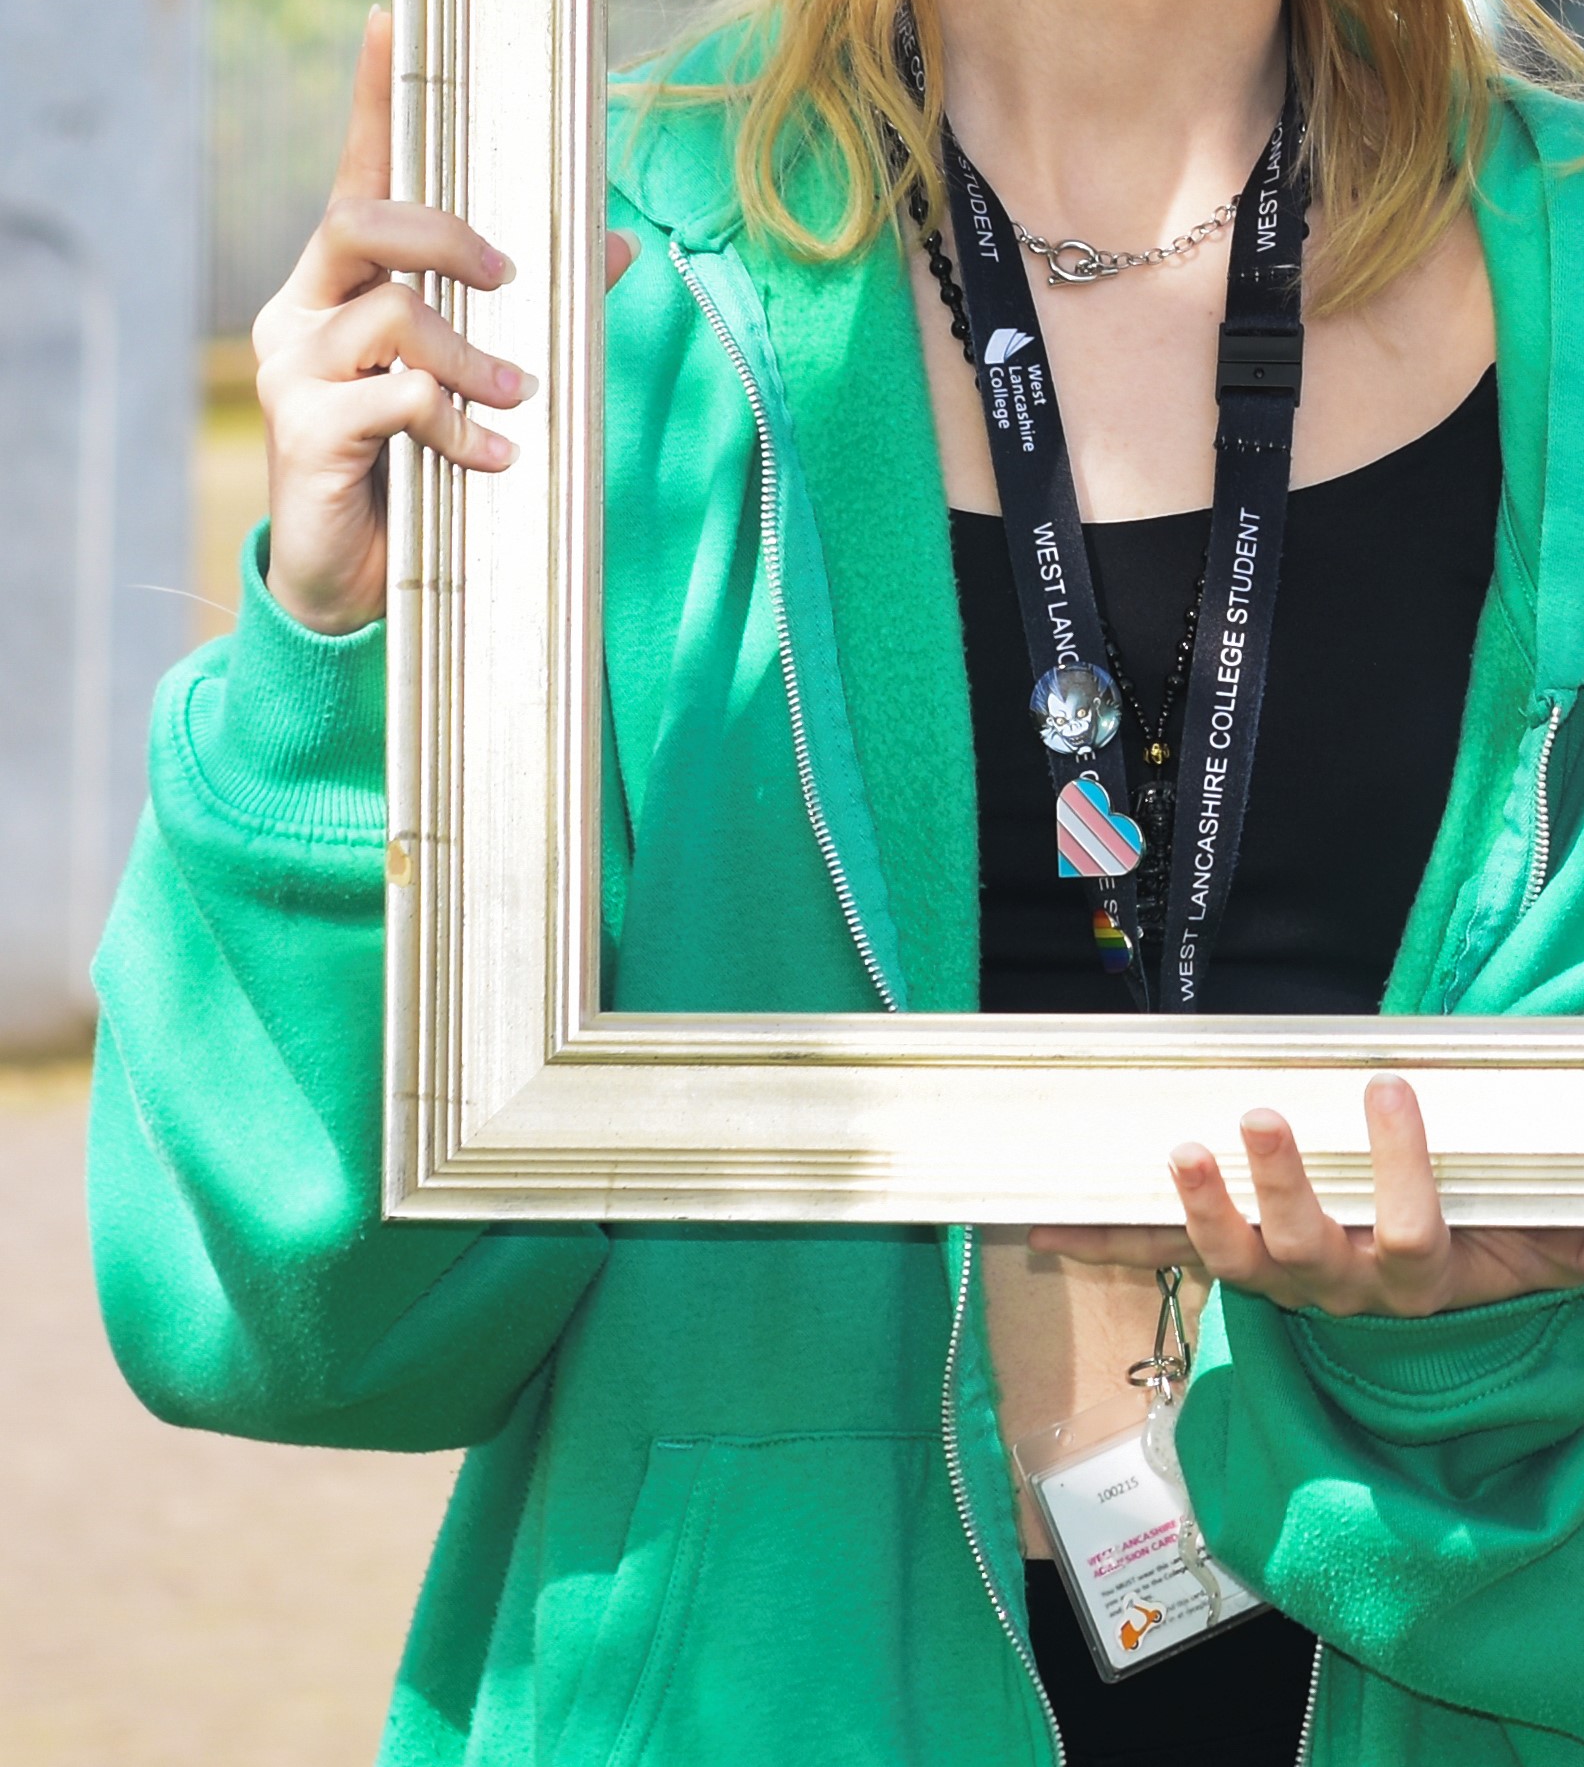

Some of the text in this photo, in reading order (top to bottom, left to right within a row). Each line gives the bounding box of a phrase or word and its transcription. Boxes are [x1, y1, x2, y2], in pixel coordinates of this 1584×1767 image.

[958, 155, 999, 262] STUDENT
[1256, 189, 1278, 252] WEST
[989, 367, 1010, 429] College
[1008, 366, 1036, 452] Lancashire
[1028, 364, 1047, 405] West
[1033, 521, 1066, 595] WEST
[1179, 507, 1261, 1003] WEST LANCASHIRE COLLEGE STUDENT
[1097, 1476, 1139, 1504] 100215
[1121, 1519, 1177, 1553] ANCASHIRE
